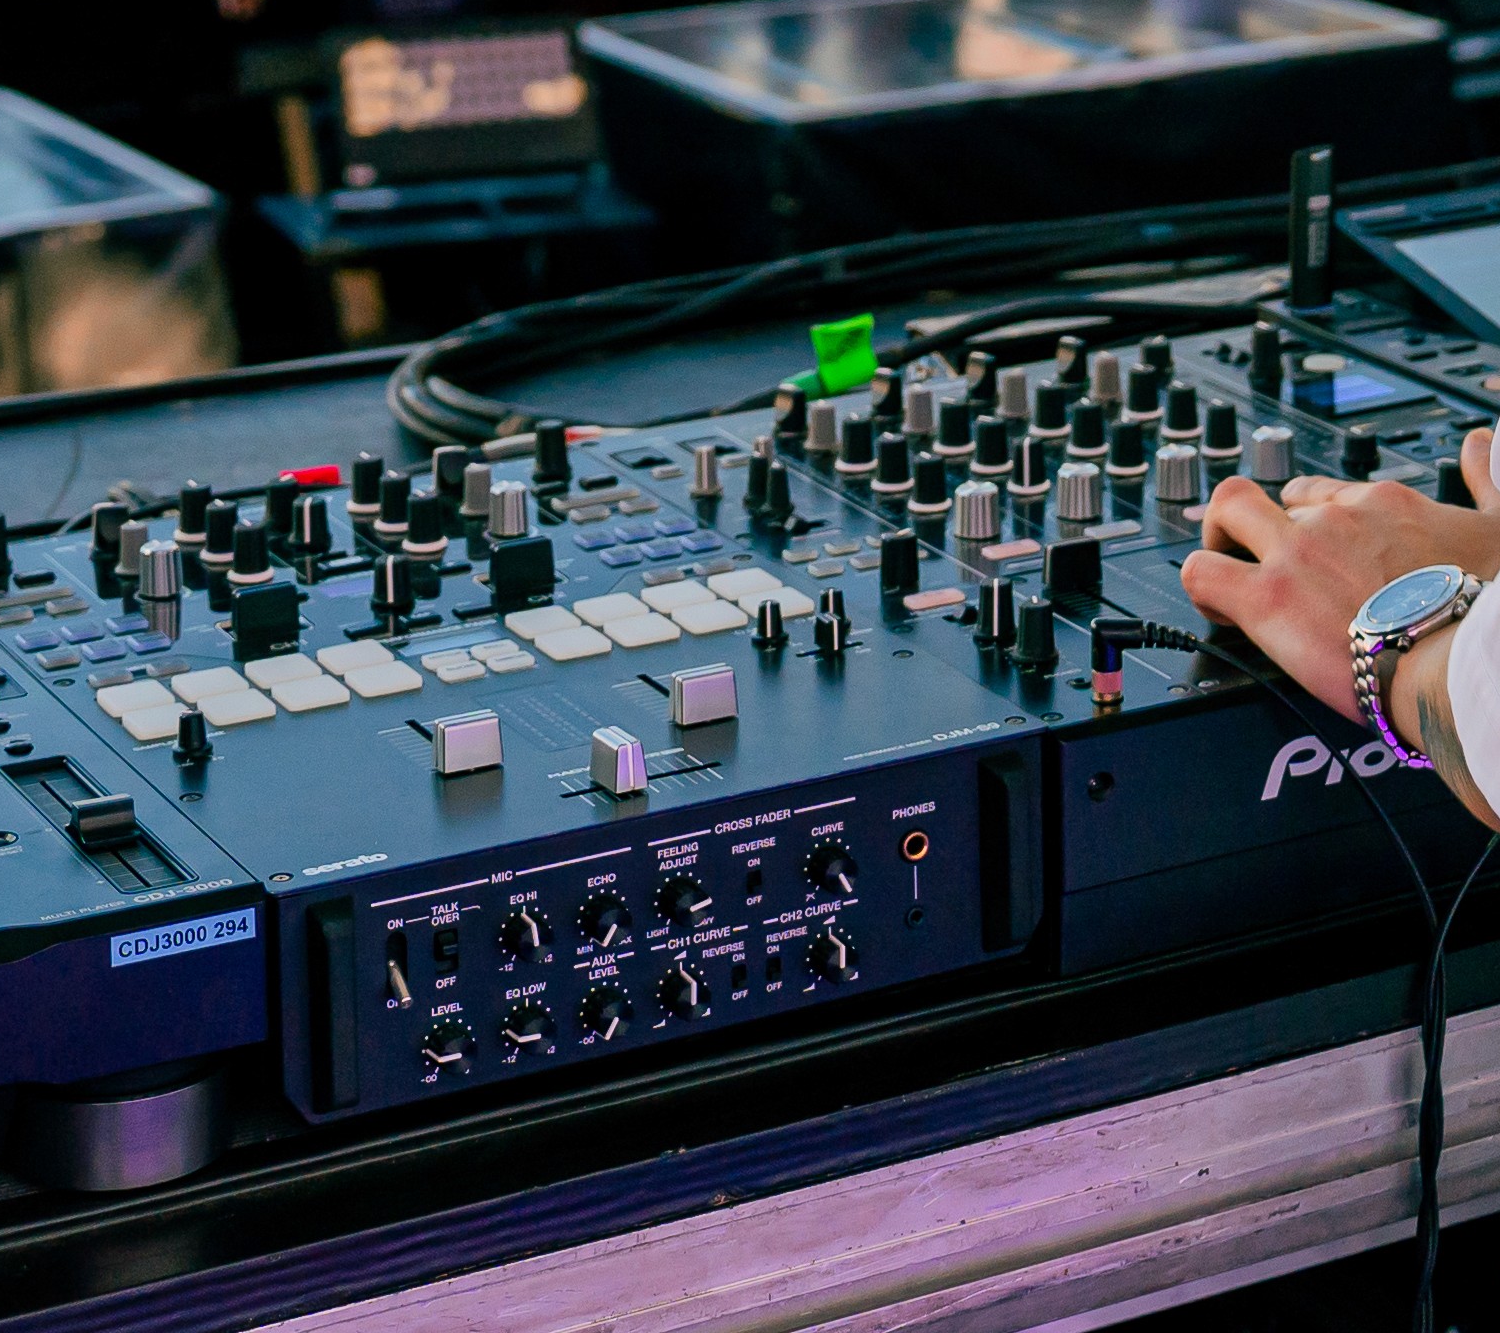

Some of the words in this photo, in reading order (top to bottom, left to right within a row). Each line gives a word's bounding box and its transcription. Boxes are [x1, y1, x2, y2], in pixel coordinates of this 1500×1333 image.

[1261, 735, 1406, 801] Pio
[892, 801, 936, 820] PHONES
[714, 817, 753, 835] CROSS
[755, 809, 791, 825] FADER
[811, 821, 844, 837] CURVE
[657, 841, 699, 859] FEELING
[731, 836, 776, 855] REVERSE
[302, 852, 389, 876] serato
[659, 854, 698, 871] ADJUST
[747, 857, 761, 867] ON
[491, 871, 513, 885] MIC
[587, 873, 617, 888] ECHO
[133, 878, 233, 903] CDJ-3000
[510, 893, 525, 905] EQ
[526, 890, 538, 902] HI
[746, 895, 763, 906] OFF
[431, 902, 459, 916] TALK
[780, 909, 803, 924] CH2
[805, 900, 842, 918] CURVE
[387, 918, 404, 930] ON
[431, 912, 460, 926] OVER
[693, 915, 715, 928] AVY
[118, 925, 207, 958] CDJ3000
[213, 917, 249, 939] 294
[646, 926, 670, 939] LIGHT
[693, 926, 731, 944] CURVE
[766, 926, 808, 944] REVERSE
[576, 944, 594, 955] MIN
[702, 941, 745, 958] REVERSE
[767, 944, 780, 954] ON
[591, 953, 616, 968] AUX
[732, 952, 746, 963] ON
[588, 965, 620, 981] LEVEL
[436, 976, 457, 989] OFF
[766, 981, 783, 993] OFF
[505, 988, 521, 1000] EQ
[522, 982, 547, 996] LOW
[731, 989, 748, 1001] OFF
[431, 1002, 463, 1017] LEVEL
